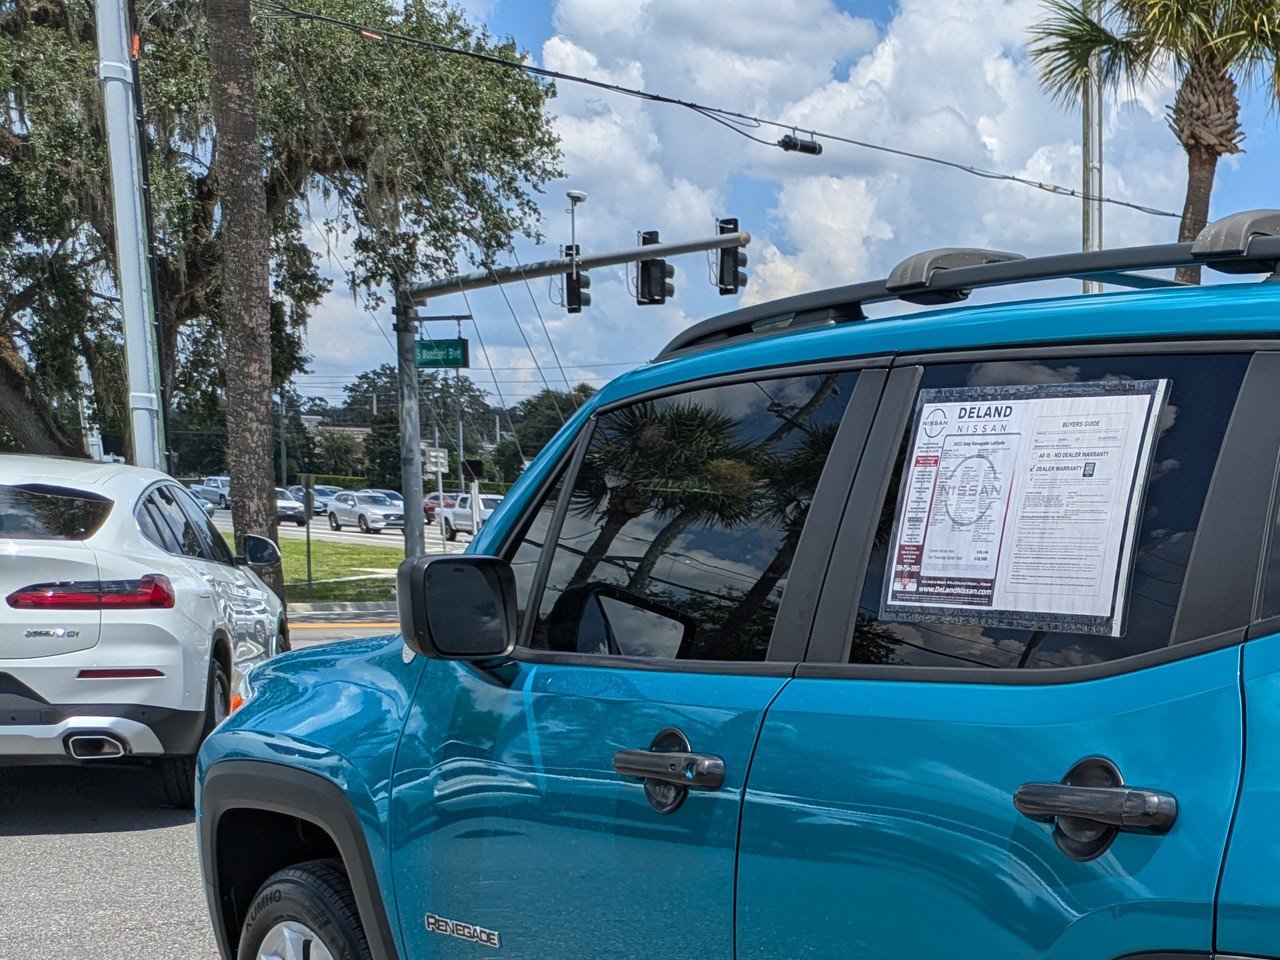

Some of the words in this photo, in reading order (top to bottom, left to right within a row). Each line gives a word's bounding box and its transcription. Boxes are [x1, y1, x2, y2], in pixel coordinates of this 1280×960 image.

[958, 406, 1013, 419] DELAND
[957, 424, 1007, 433] NISSAN
[940, 485, 1001, 496] NISSAN
[425, 912, 499, 948] RENEGADE
